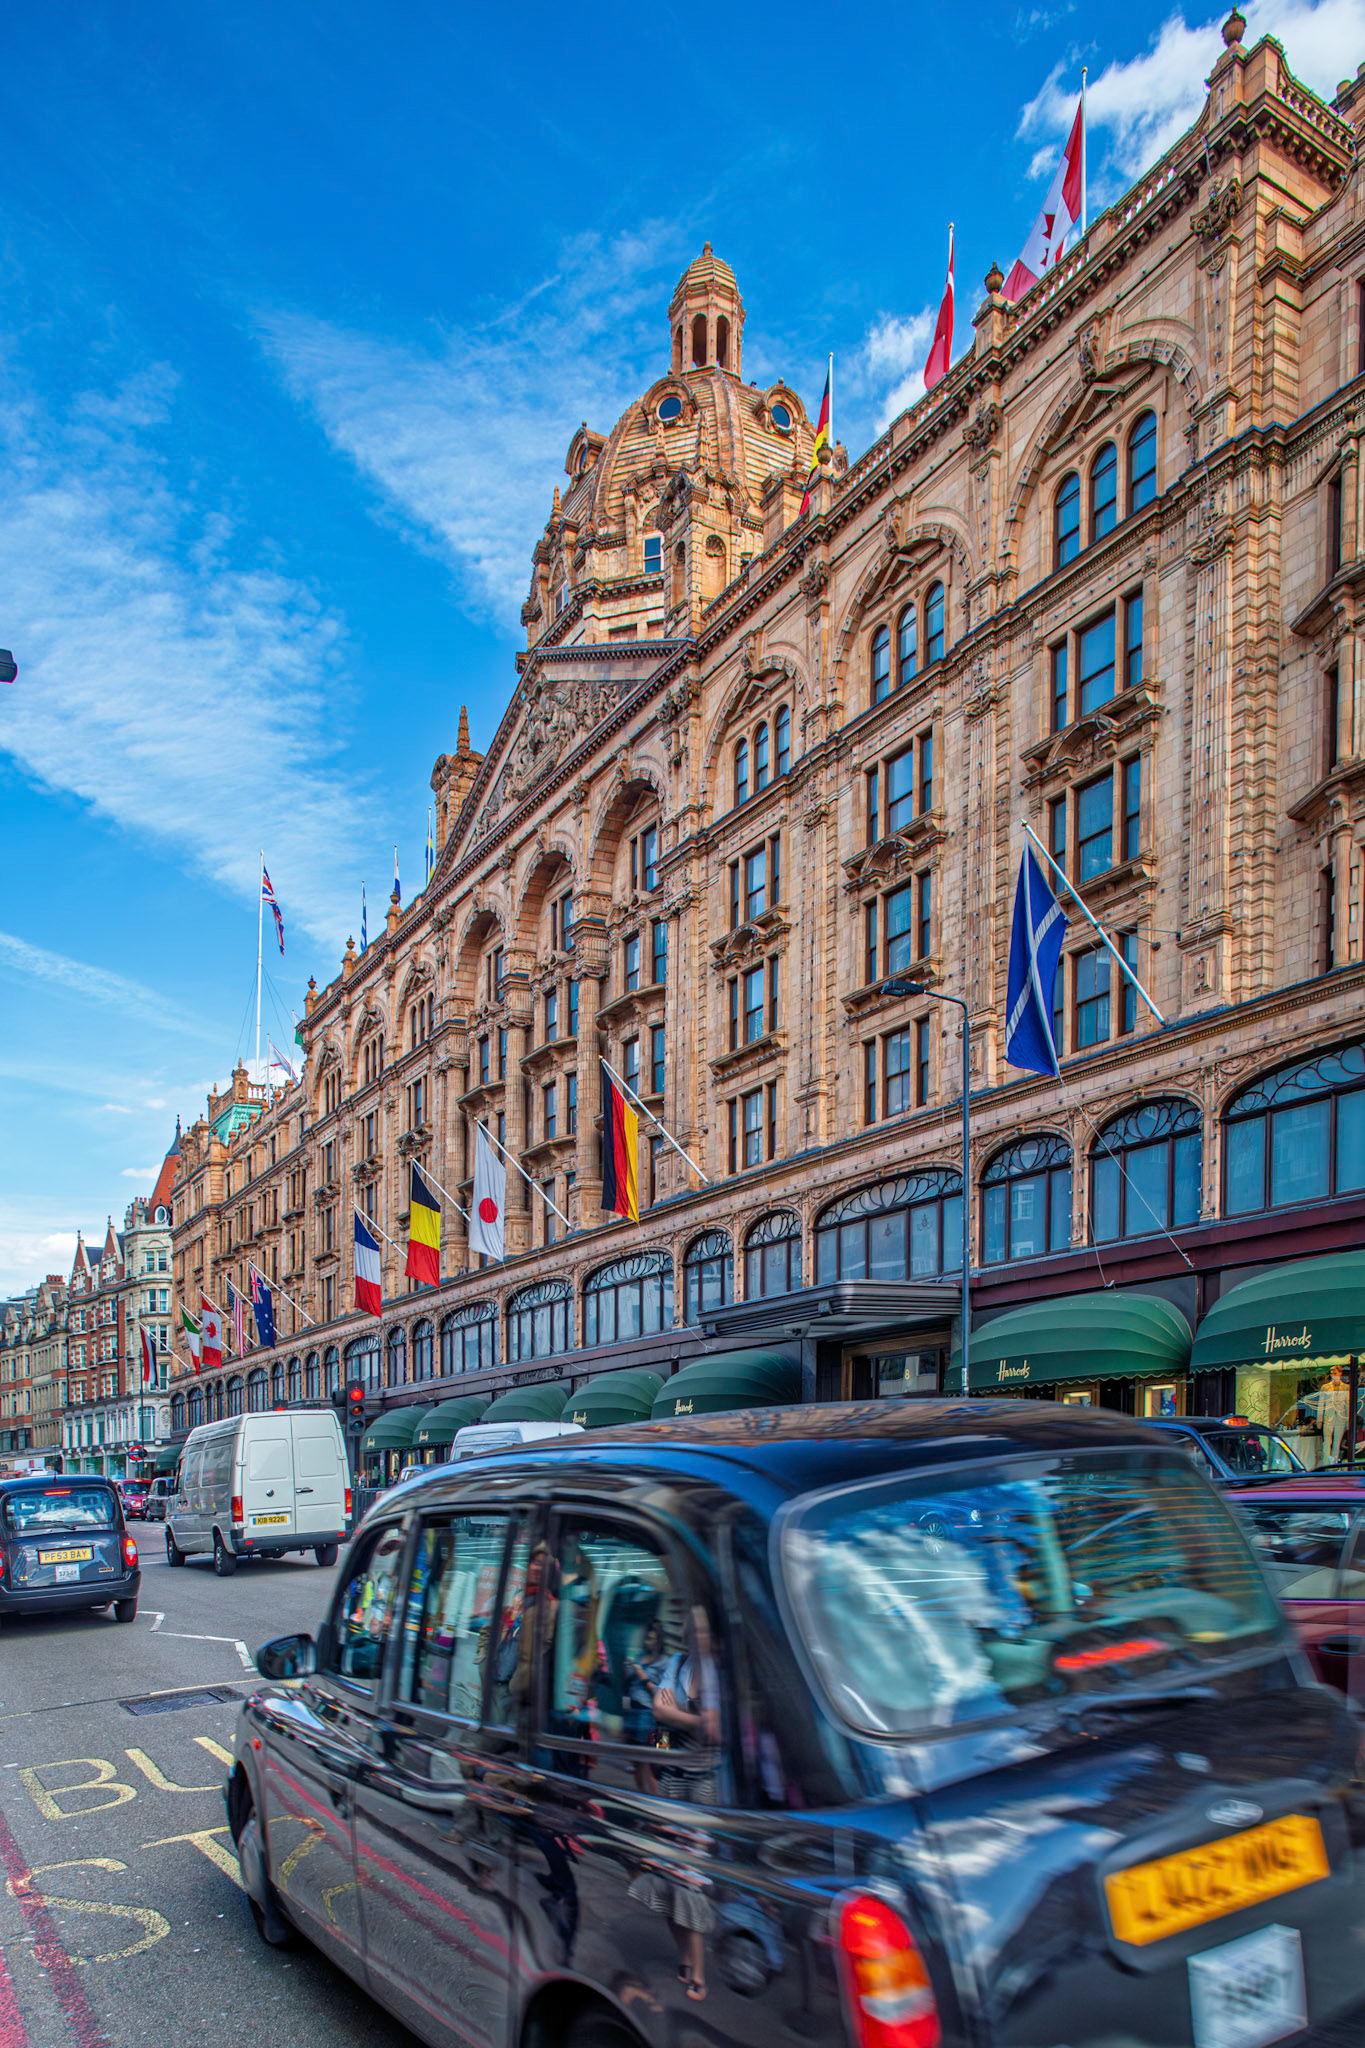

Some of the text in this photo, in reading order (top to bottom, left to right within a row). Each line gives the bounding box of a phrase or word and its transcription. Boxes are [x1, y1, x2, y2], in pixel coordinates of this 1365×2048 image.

[1261, 1326, 1312, 1353] Harrods
[904, 1368, 911, 1380] 8
[996, 1360, 1030, 1381] Harrods
[44, 1549, 87, 1561] PF53 BAY
[18, 1734, 236, 1820] BU
[5, 1825, 246, 1968] ST
